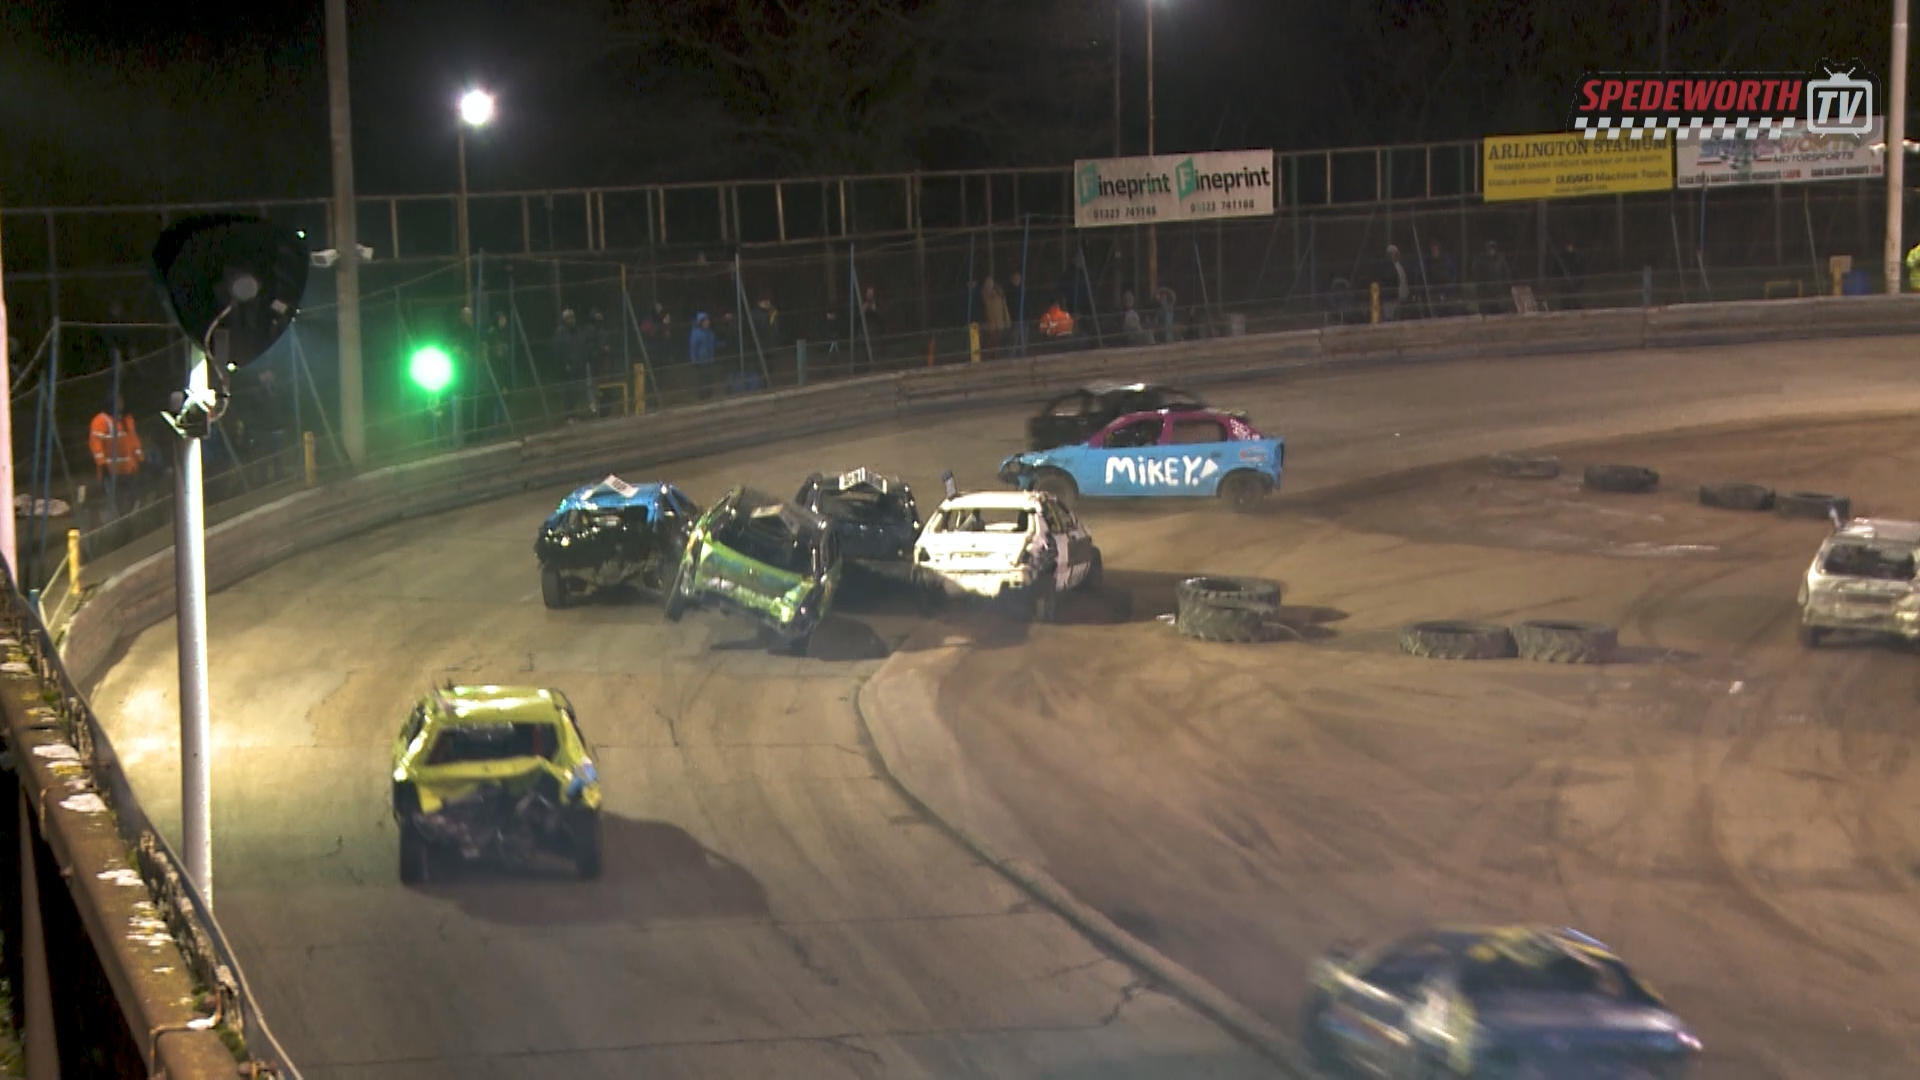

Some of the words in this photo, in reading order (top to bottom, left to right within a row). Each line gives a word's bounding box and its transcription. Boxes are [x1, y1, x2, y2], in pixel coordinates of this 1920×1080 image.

[1488, 139, 1588, 160] ARLINGTON
[1593, 135, 1667, 153] STADIUM
[1773, 151, 1854, 163] MOTORSPORTS
